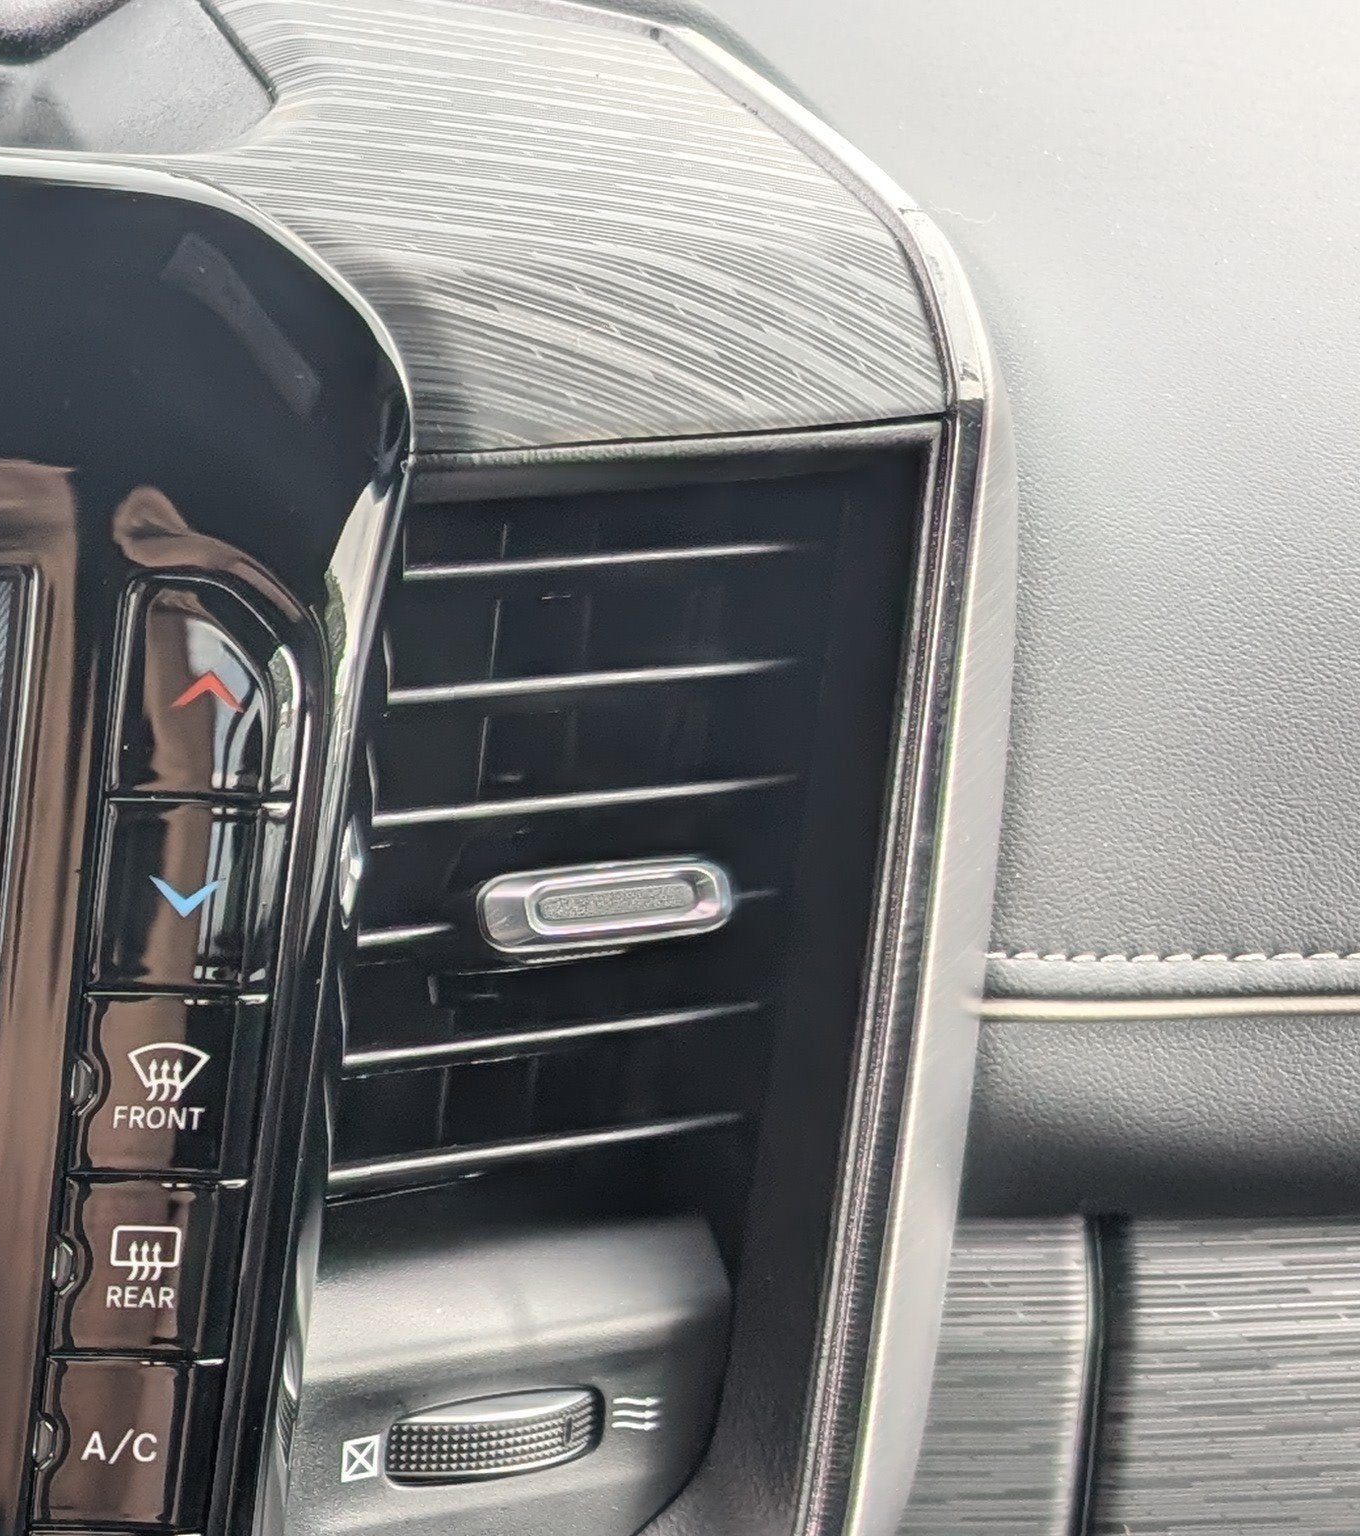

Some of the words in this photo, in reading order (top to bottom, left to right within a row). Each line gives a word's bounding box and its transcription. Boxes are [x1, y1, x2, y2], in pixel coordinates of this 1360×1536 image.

[112, 1105, 205, 1130] FRONT
[106, 1285, 175, 1309] REAR
[80, 1428, 158, 1465] A/C
